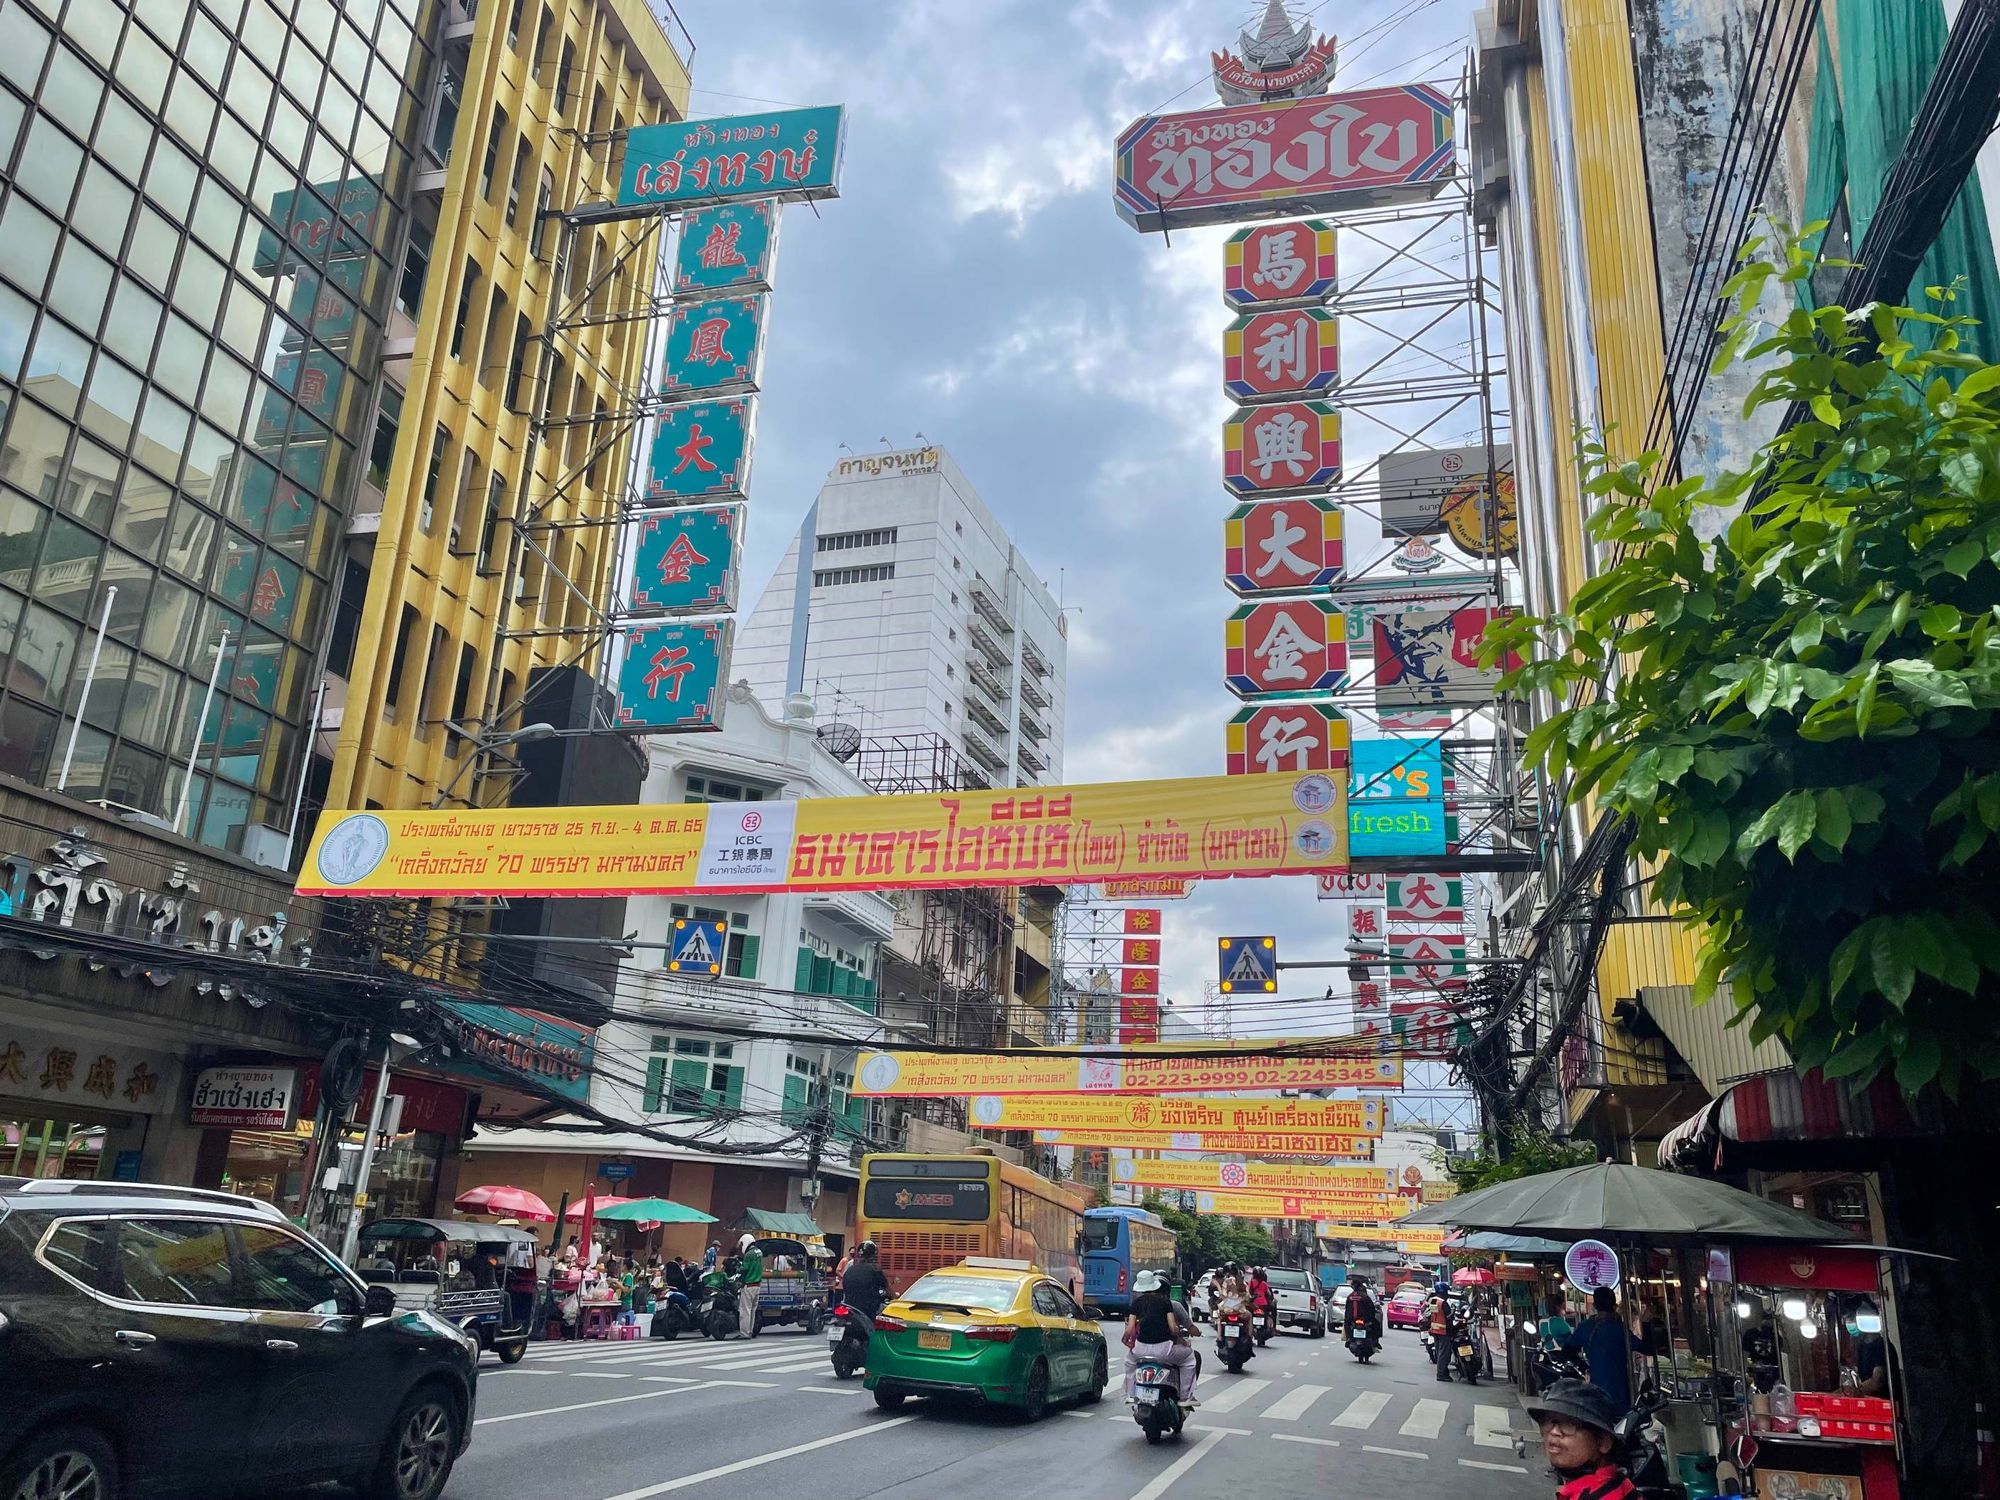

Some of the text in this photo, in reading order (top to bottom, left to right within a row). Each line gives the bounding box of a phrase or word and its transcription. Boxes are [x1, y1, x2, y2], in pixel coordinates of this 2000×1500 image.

[684, 122, 781, 148] ห้างทอง
[1151, 116, 1277, 149] ห้างทอง
[565, 821, 584, 836] 25
[1351, 810, 1432, 833] fresh
[735, 835, 763, 845] ICBC
[497, 853, 524, 874] 70
[530, 854, 591, 875] พรรษา
[962, 1075, 977, 1084] 70
[195, 1079, 286, 1109] ฮั่วเซ่งเฮง
[1048, 1112, 1059, 1121] 70
